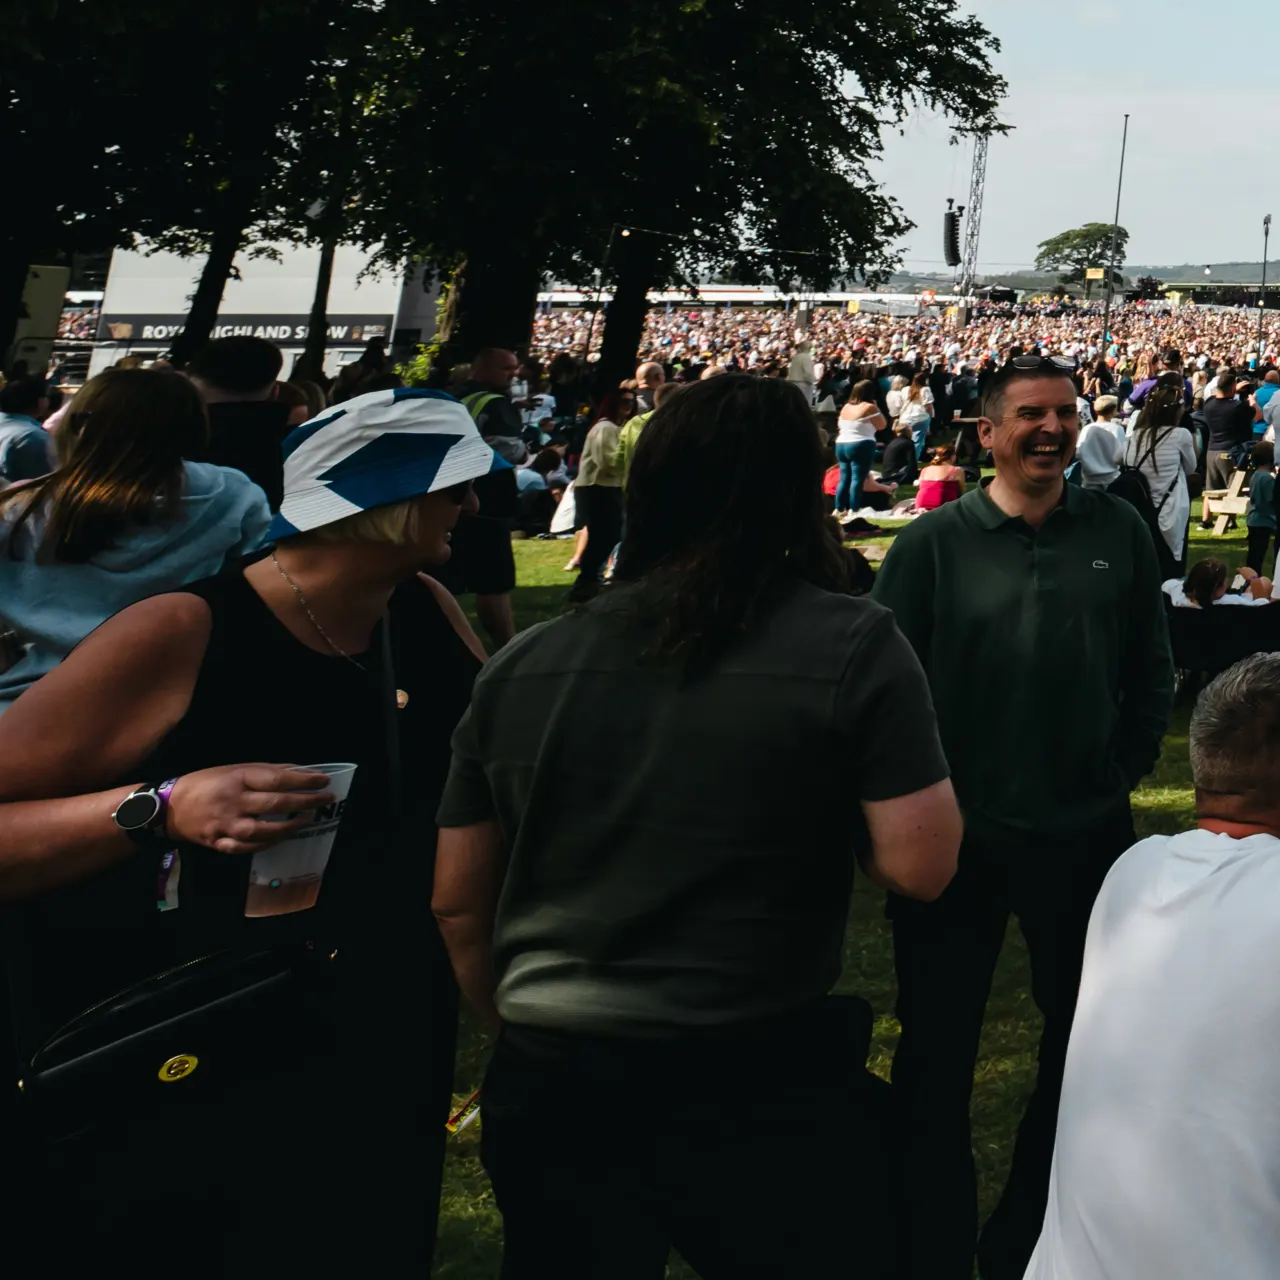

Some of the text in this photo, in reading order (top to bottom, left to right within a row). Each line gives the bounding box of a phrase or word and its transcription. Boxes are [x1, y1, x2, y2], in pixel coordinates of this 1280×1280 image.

[142, 325, 186, 339] ROY
[208, 325, 293, 339] IGHLAND
[293, 325, 348, 339] SW
